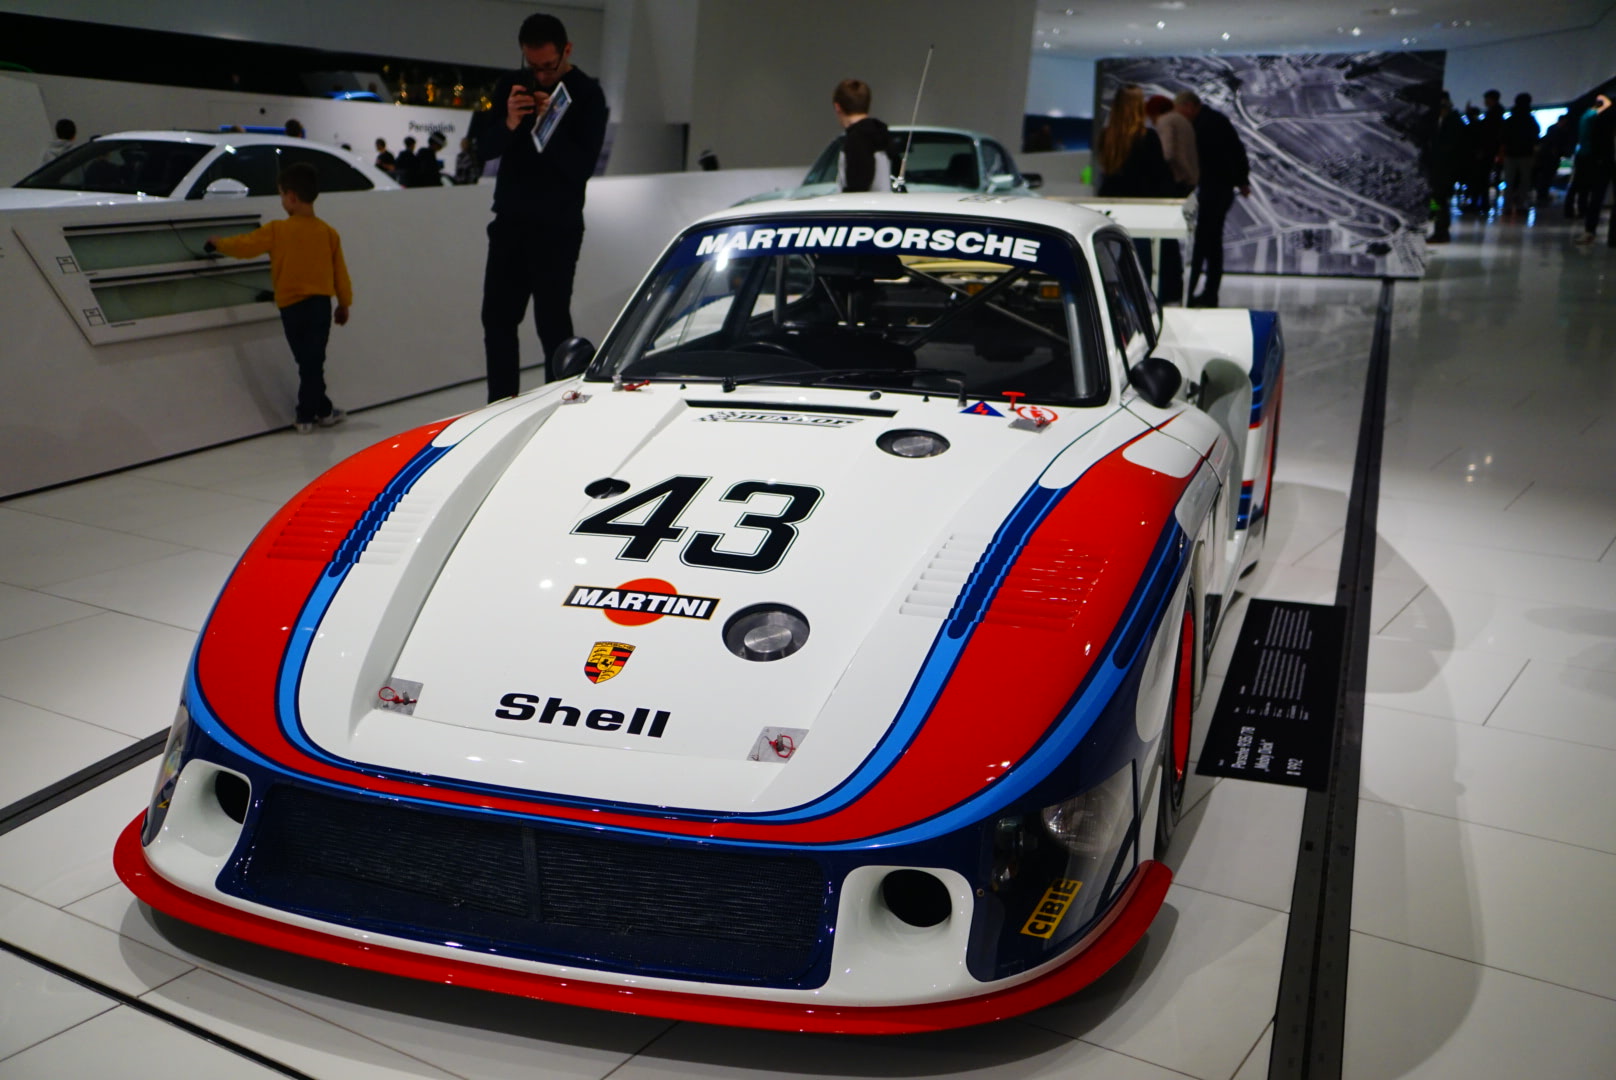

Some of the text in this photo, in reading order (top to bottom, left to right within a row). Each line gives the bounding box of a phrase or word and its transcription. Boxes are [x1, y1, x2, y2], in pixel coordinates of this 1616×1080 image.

[569, 474, 825, 574] 43
[570, 587, 712, 618] MARTINI
[494, 692, 671, 738] Shell
